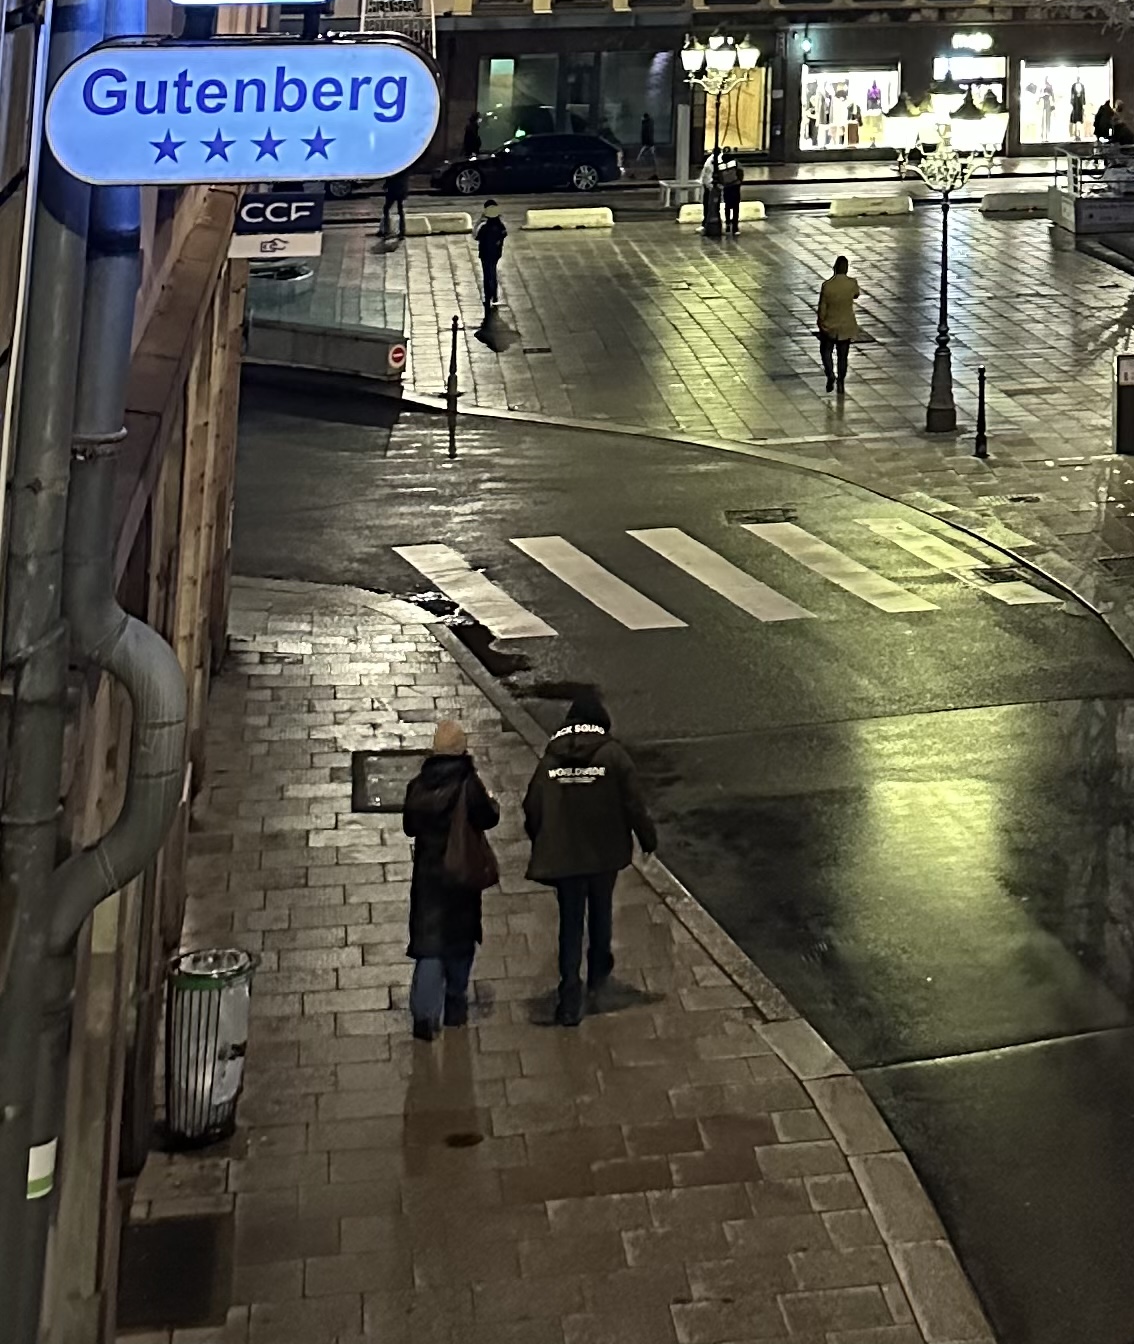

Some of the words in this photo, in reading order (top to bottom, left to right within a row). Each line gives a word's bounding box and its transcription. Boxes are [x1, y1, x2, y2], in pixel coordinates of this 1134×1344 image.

[82, 66, 407, 123] Gutenberg
[240, 201, 316, 223] CCF
[574, 723, 605, 735] SQUAD
[548, 766, 606, 777] WORLDWIDE
